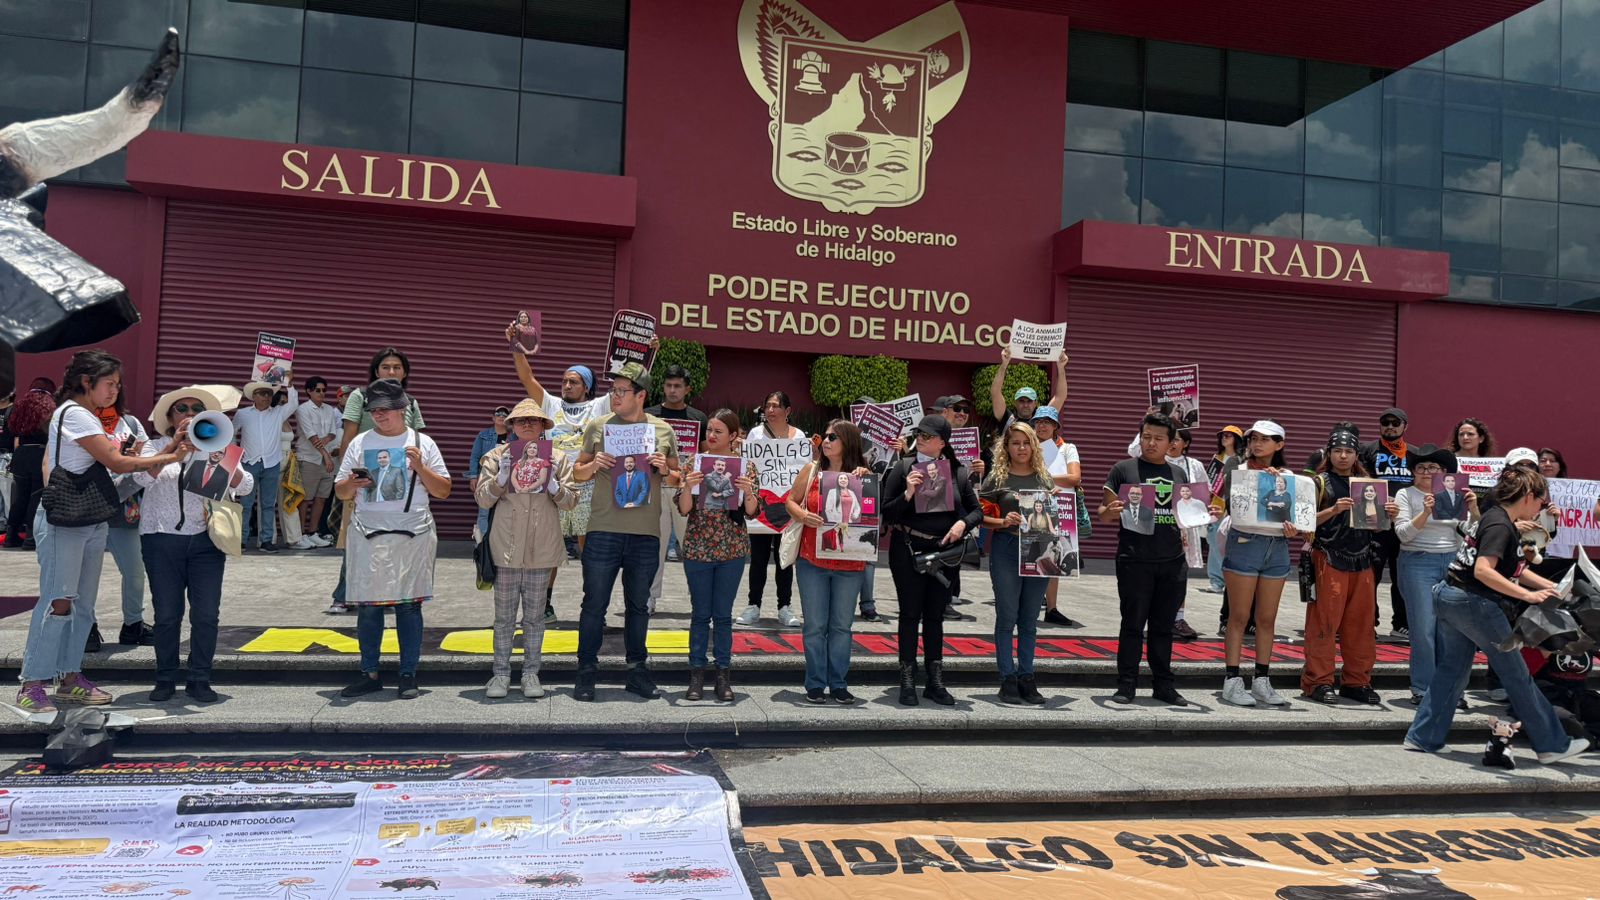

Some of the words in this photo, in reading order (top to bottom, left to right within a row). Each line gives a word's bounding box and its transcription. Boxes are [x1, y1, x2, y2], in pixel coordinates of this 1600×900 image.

[281, 149, 502, 209] SALIDA
[732, 211, 797, 235] Estado
[803, 218, 849, 239] Libre
[856, 224, 866, 243] y
[871, 224, 958, 247] Soberano
[796, 241, 819, 258] de
[825, 242, 896, 267] Hidalgo
[1166, 231, 1373, 283] ENTRADA
[708, 273, 809, 304] PODER
[817, 282, 971, 315] EJECUTIVO
[660, 302, 718, 329] DEL
[726, 306, 841, 338] ESTADO
[850, 315, 886, 341] DE
[894, 319, 1011, 349] HIDALGO
[628, 350, 644, 360] TOROS
[740, 440, 811, 459] HIDALGO
[764, 459, 786, 472] SIN
[1376, 467, 1412, 476] LATIN
[187, 819, 228, 828] REALIDAD
[230, 816, 296, 825] METODOLÓGICA
[755, 834, 1114, 878] HIDALGO
[1114, 829, 1270, 868] SIN
[1247, 827, 1600, 866] TAUROM
